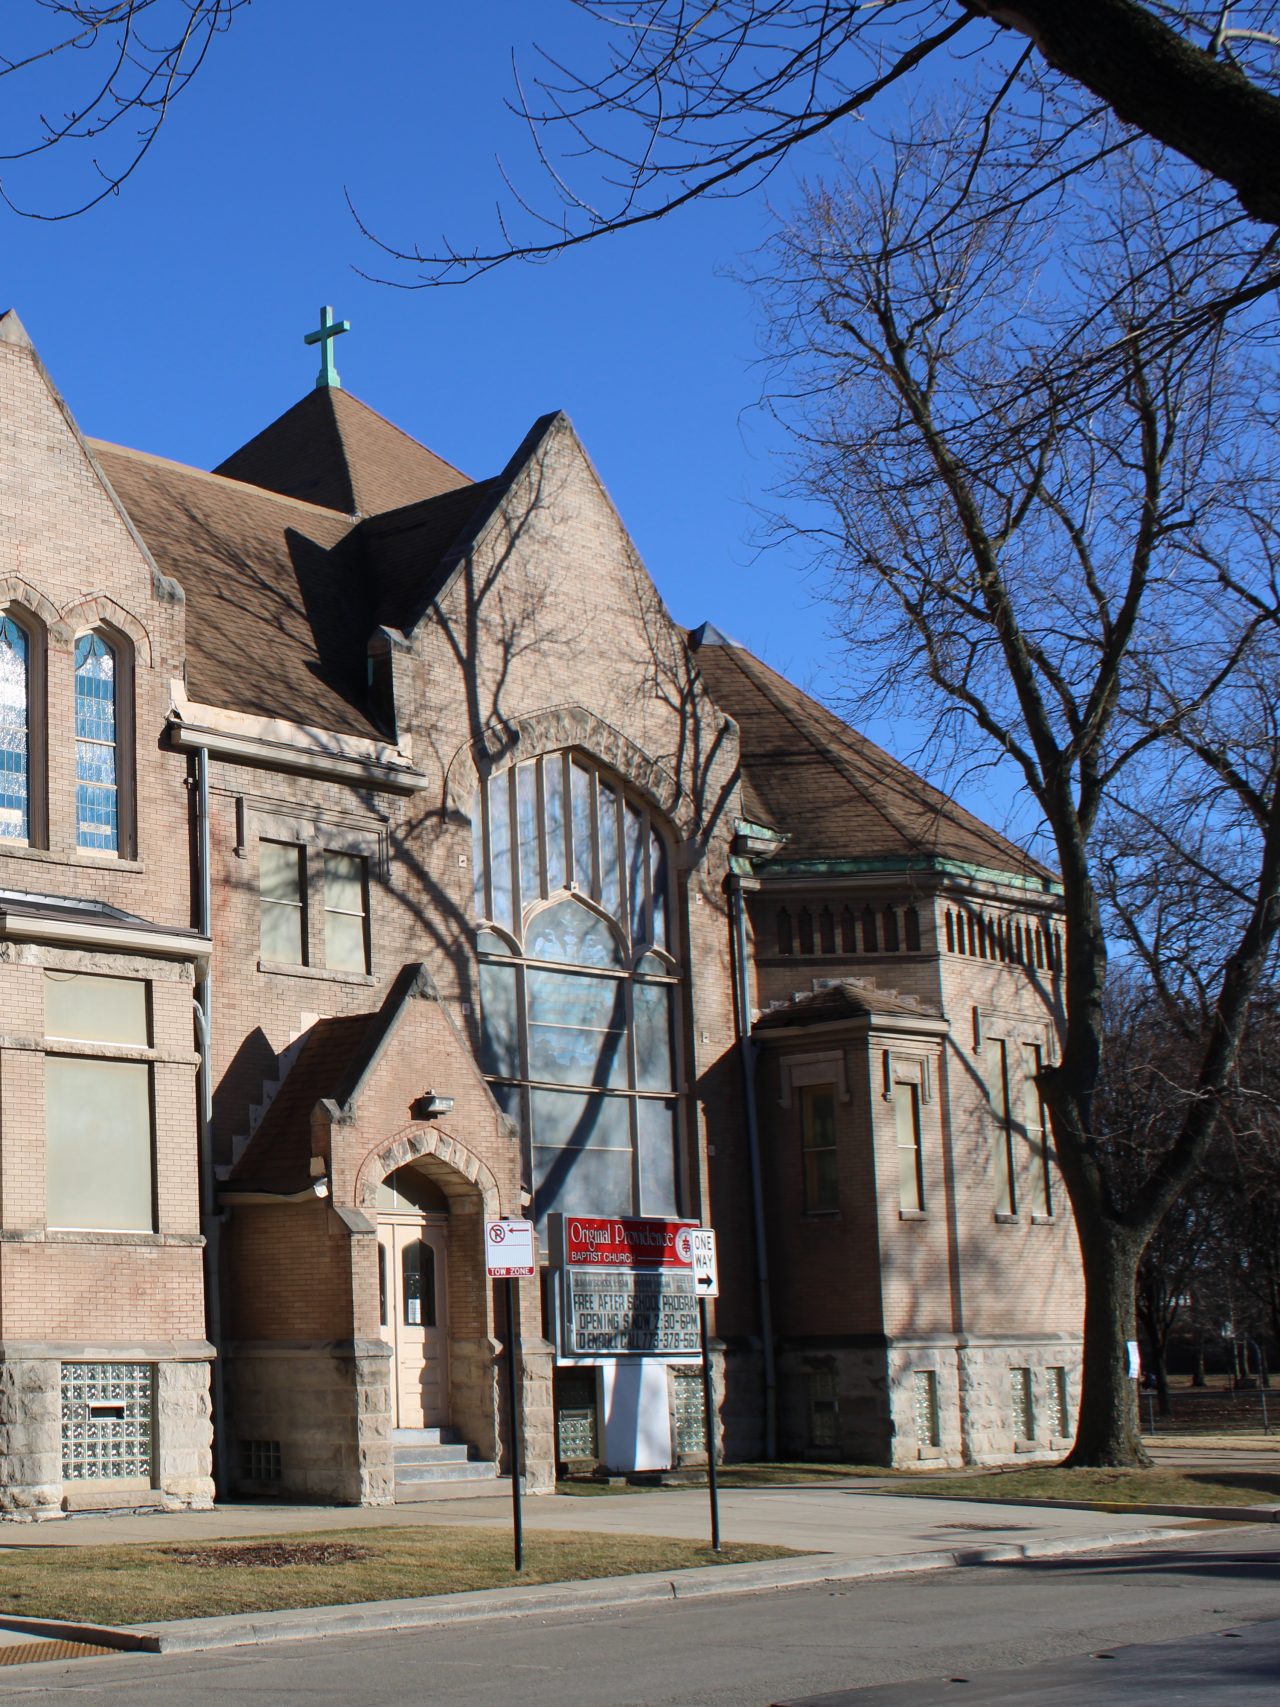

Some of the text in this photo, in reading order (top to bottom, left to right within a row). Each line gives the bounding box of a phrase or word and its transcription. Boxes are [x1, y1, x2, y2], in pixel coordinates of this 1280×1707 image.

[571, 1222, 674, 1251] Original Providence
[695, 1236, 712, 1251] ONE
[571, 1251, 637, 1263] BAPTIST CHURCH
[695, 1254, 713, 1270] WAY
[491, 1267, 529, 1276] TOW ZONE
[573, 1294, 594, 1310] FREE
[598, 1294, 625, 1310] AFTER
[627, 1294, 661, 1311] SCHOOL
[655, 1313, 698, 1330] 2:30-6PM
[587, 1332, 619, 1349] ENROLL
[620, 1333, 642, 1349] CALL
[642, 1332, 702, 1349] 773-378-567
